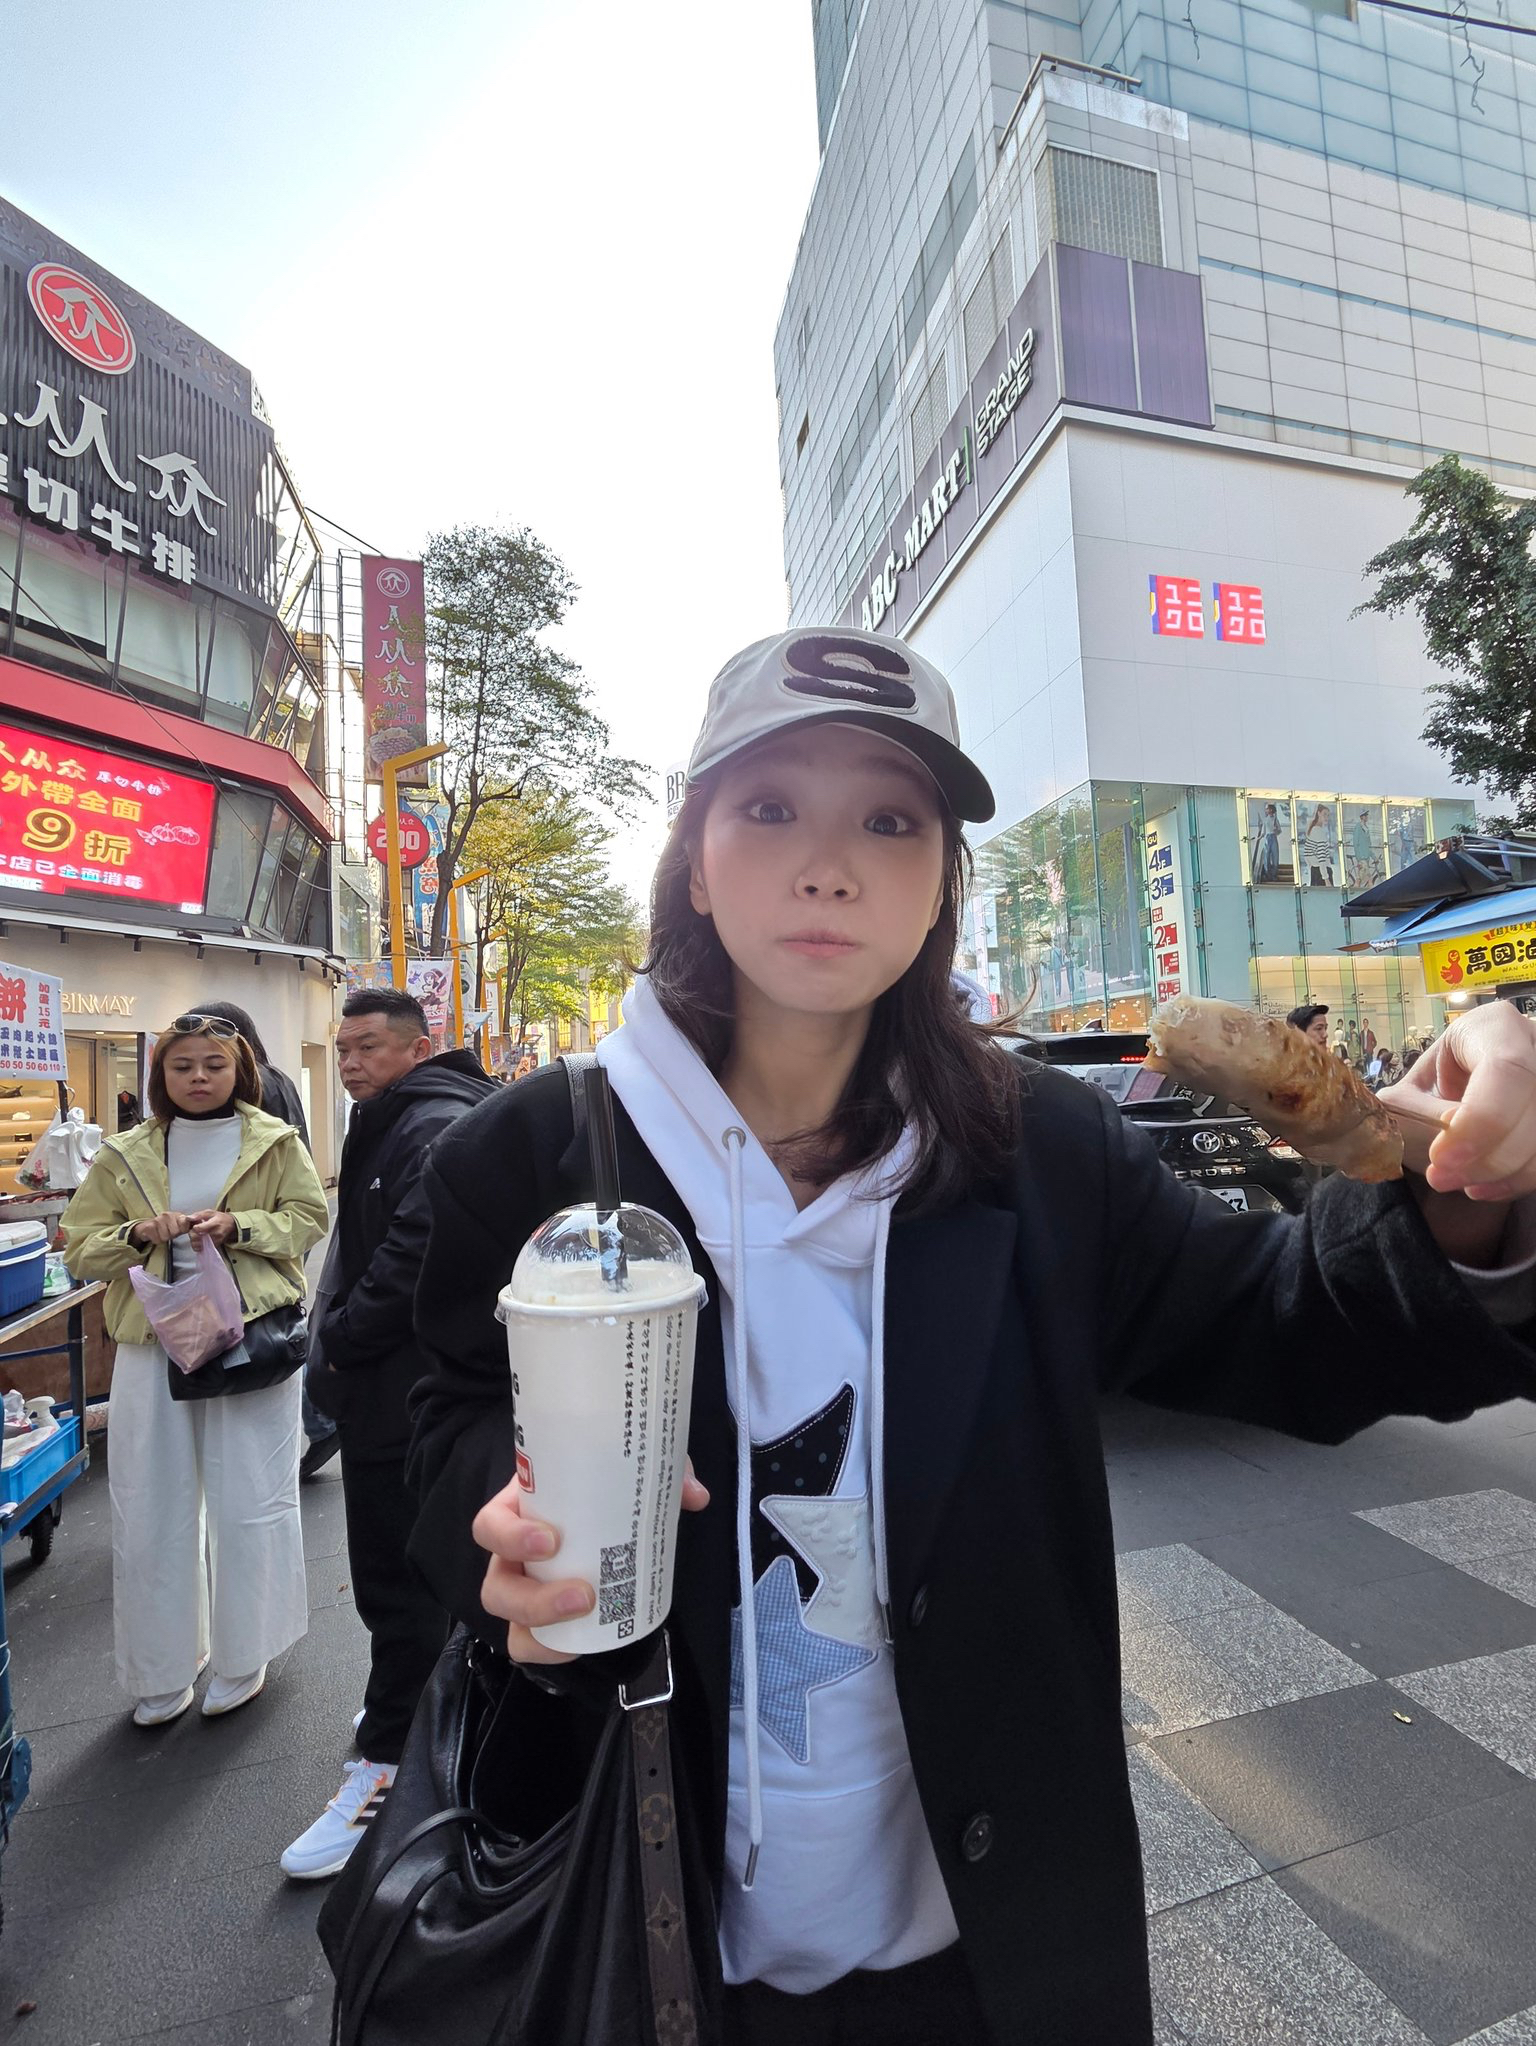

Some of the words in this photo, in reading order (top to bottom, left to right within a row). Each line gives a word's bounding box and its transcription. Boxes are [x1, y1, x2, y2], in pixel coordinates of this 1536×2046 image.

[975, 328, 1034, 433] GRAND
[976, 361, 1033, 459] STAGE
[0, 380, 227, 536] 从众
[861, 447, 962, 632] ABC-MART
[1, 770, 142, 822] 外帶全面
[1148, 835, 1157, 845] GU
[1522, 962, 1536, 970] GU
[12, 1061, 23, 1070] 50
[25, 1062, 36, 1070] 50
[37, 1063, 48, 1071] 60
[1175, 1167, 1246, 1180] CROSS
